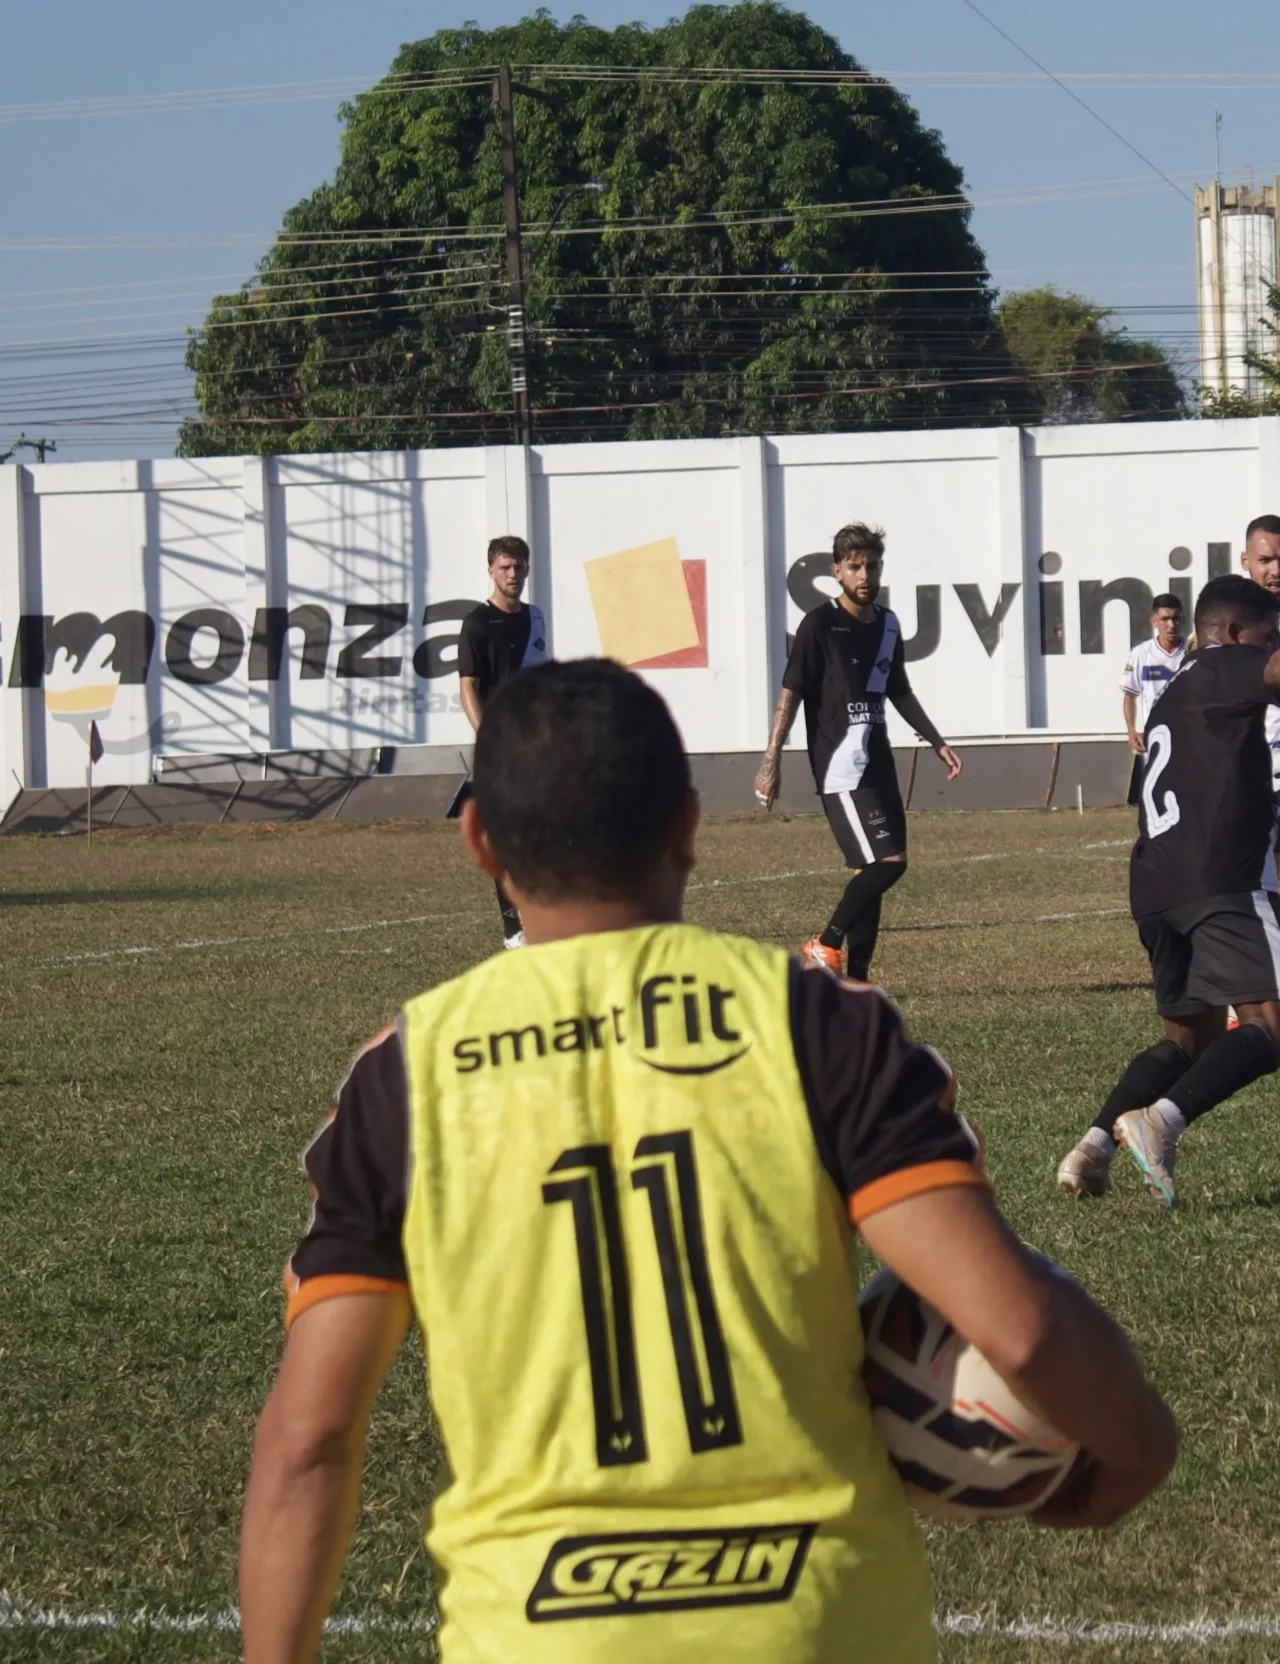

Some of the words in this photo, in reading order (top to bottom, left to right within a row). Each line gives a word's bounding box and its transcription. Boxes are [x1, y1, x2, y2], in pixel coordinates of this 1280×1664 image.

[0, 599, 487, 689] monza
[1142, 724, 1180, 839] 2
[453, 1004, 626, 1073] smart
[639, 973, 742, 1050] fit
[541, 1129, 746, 1469] 11
[551, 1537, 800, 1602] GAZIN
